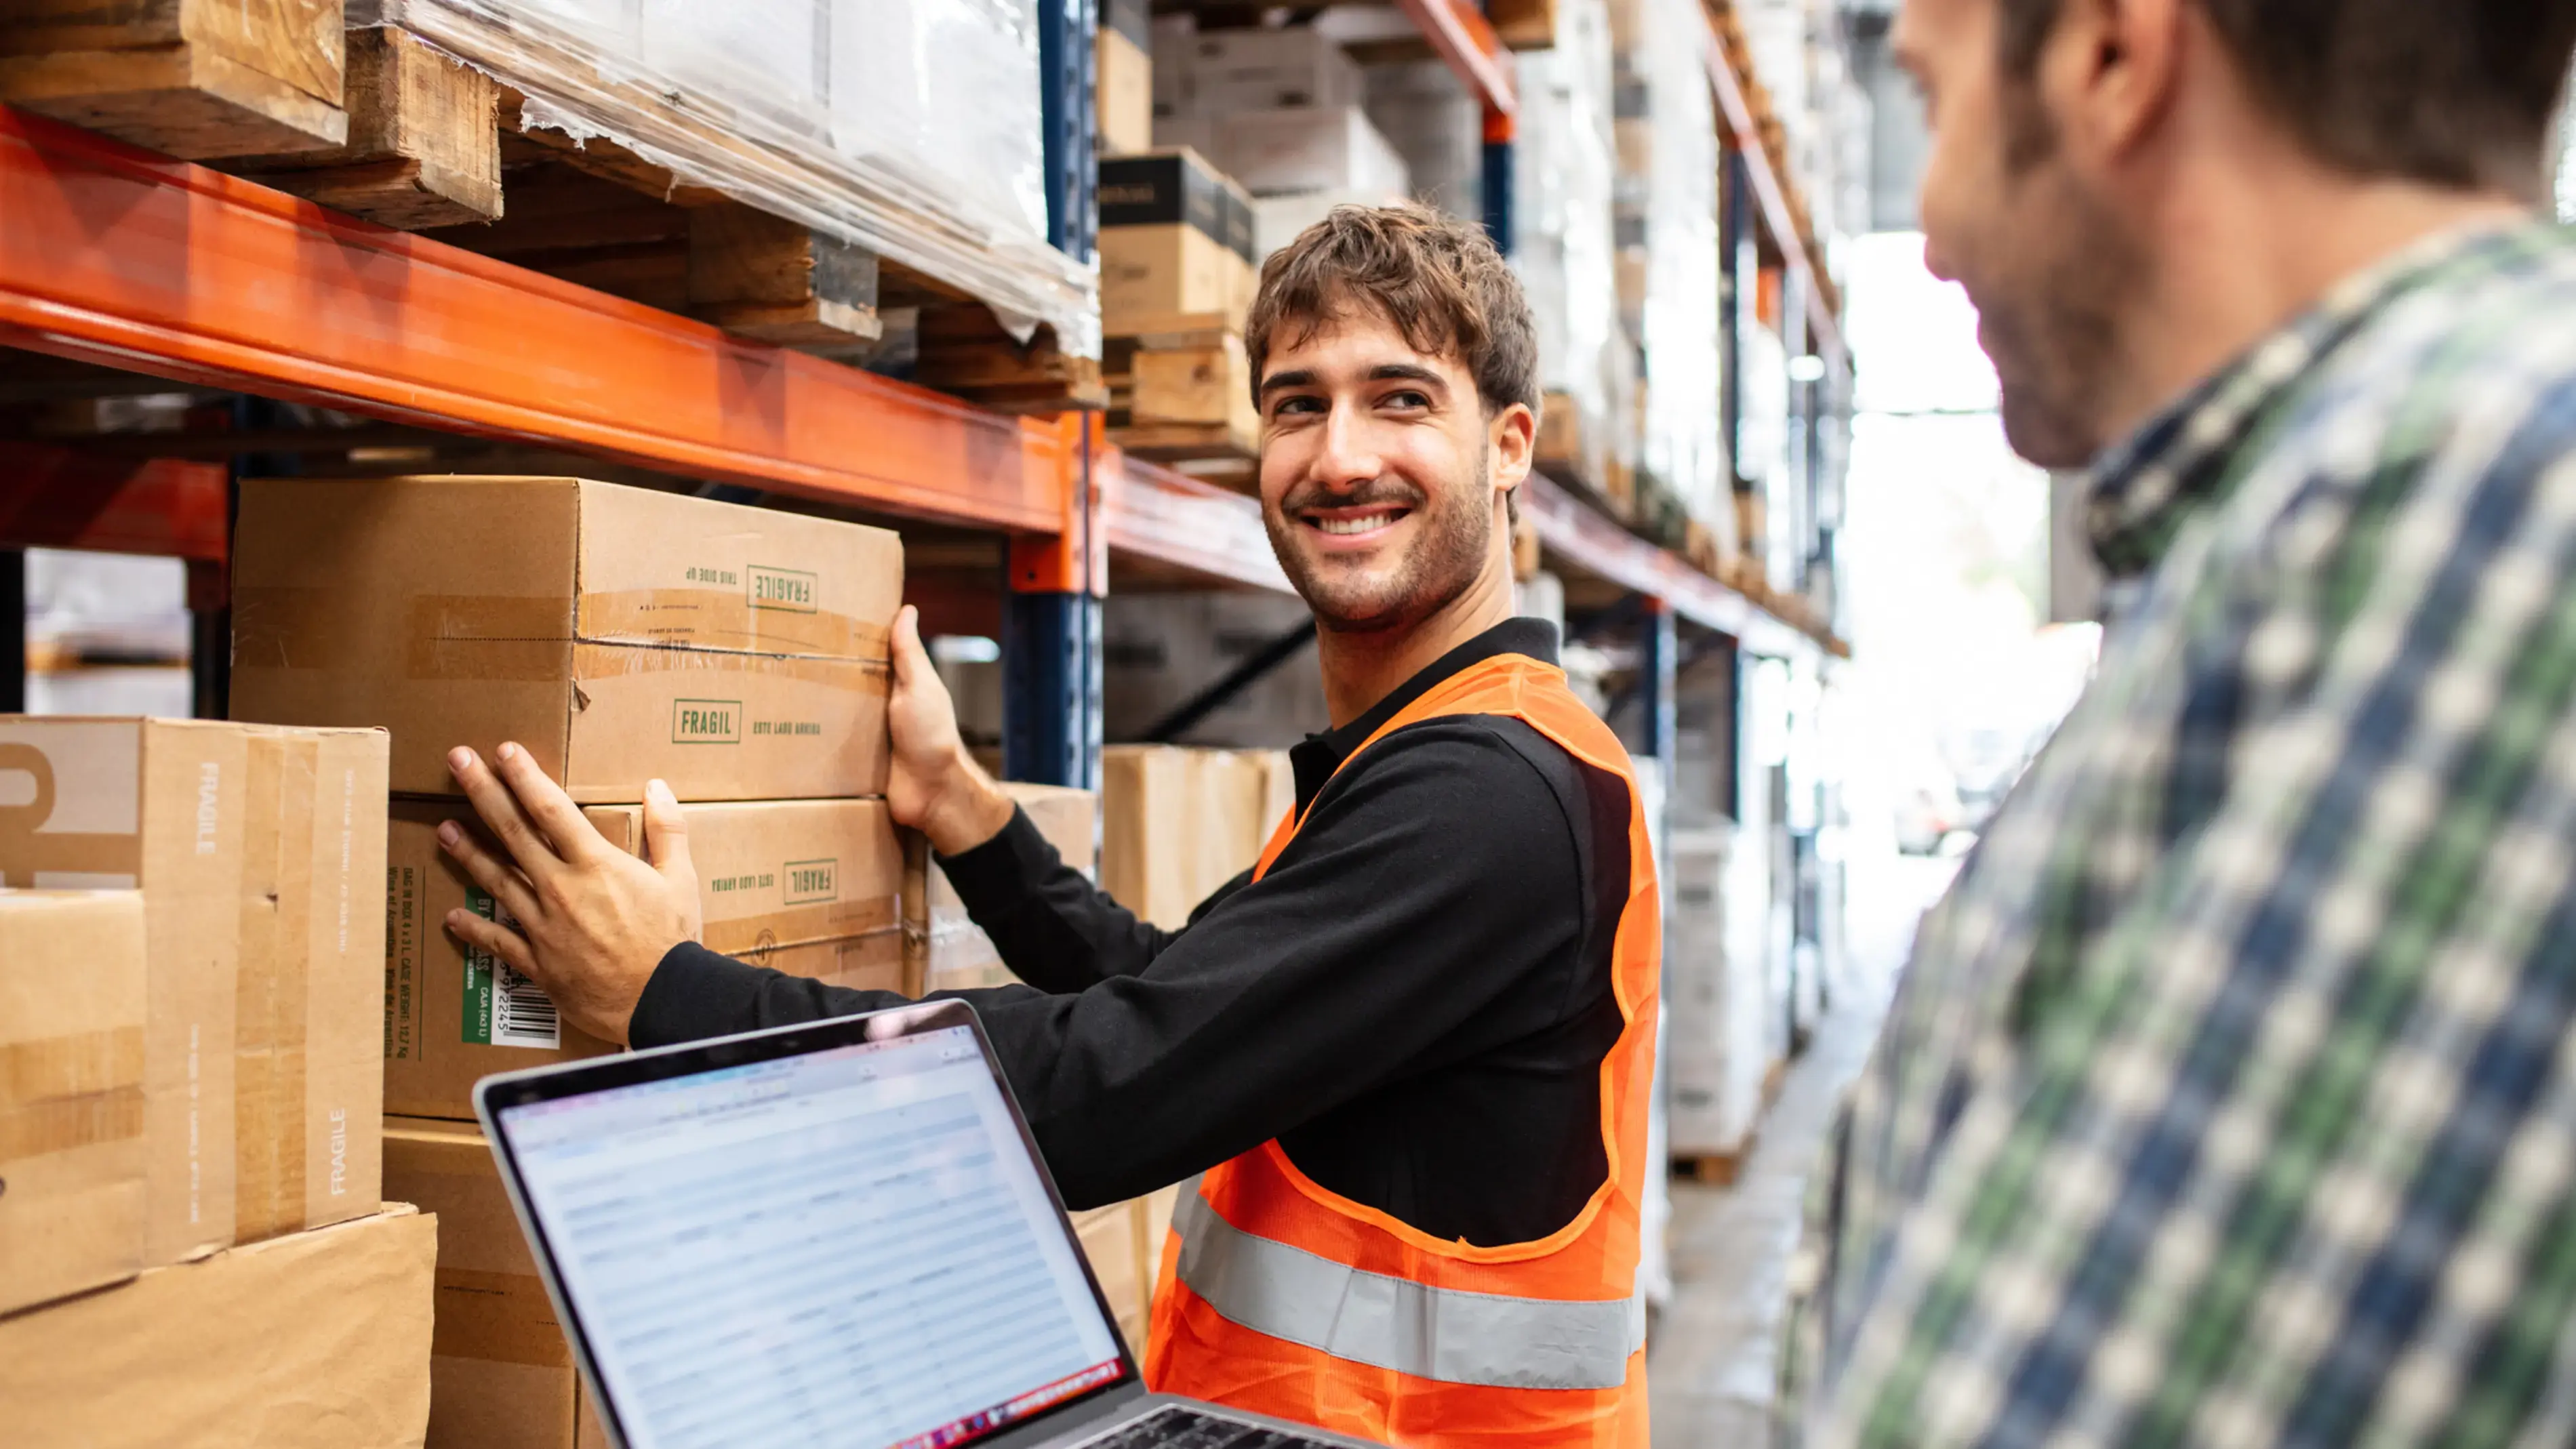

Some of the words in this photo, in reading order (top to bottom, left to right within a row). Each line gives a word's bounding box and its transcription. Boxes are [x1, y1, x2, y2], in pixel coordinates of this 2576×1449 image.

[686, 566, 696, 581] UP
[700, 568, 717, 583] SIDE
[721, 571, 737, 586] THIS
[756, 575, 810, 603] FRAGILE
[682, 710, 731, 735] FRAGIL
[753, 722, 771, 735] ESTE
[774, 722, 792, 735] LADO
[794, 722, 821, 736] ARRIBA
[197, 763, 218, 853] FRAGILE
[712, 877, 737, 893] ARRIBA
[740, 875, 756, 890] LADO
[759, 873, 774, 888] ESTE
[792, 869, 830, 893] FRAGIL
[478, 898, 491, 912] BY
[401, 957, 411, 981] CASE
[479, 987, 489, 1008] CAJA
[331, 1107, 345, 1195] FRAGILE
